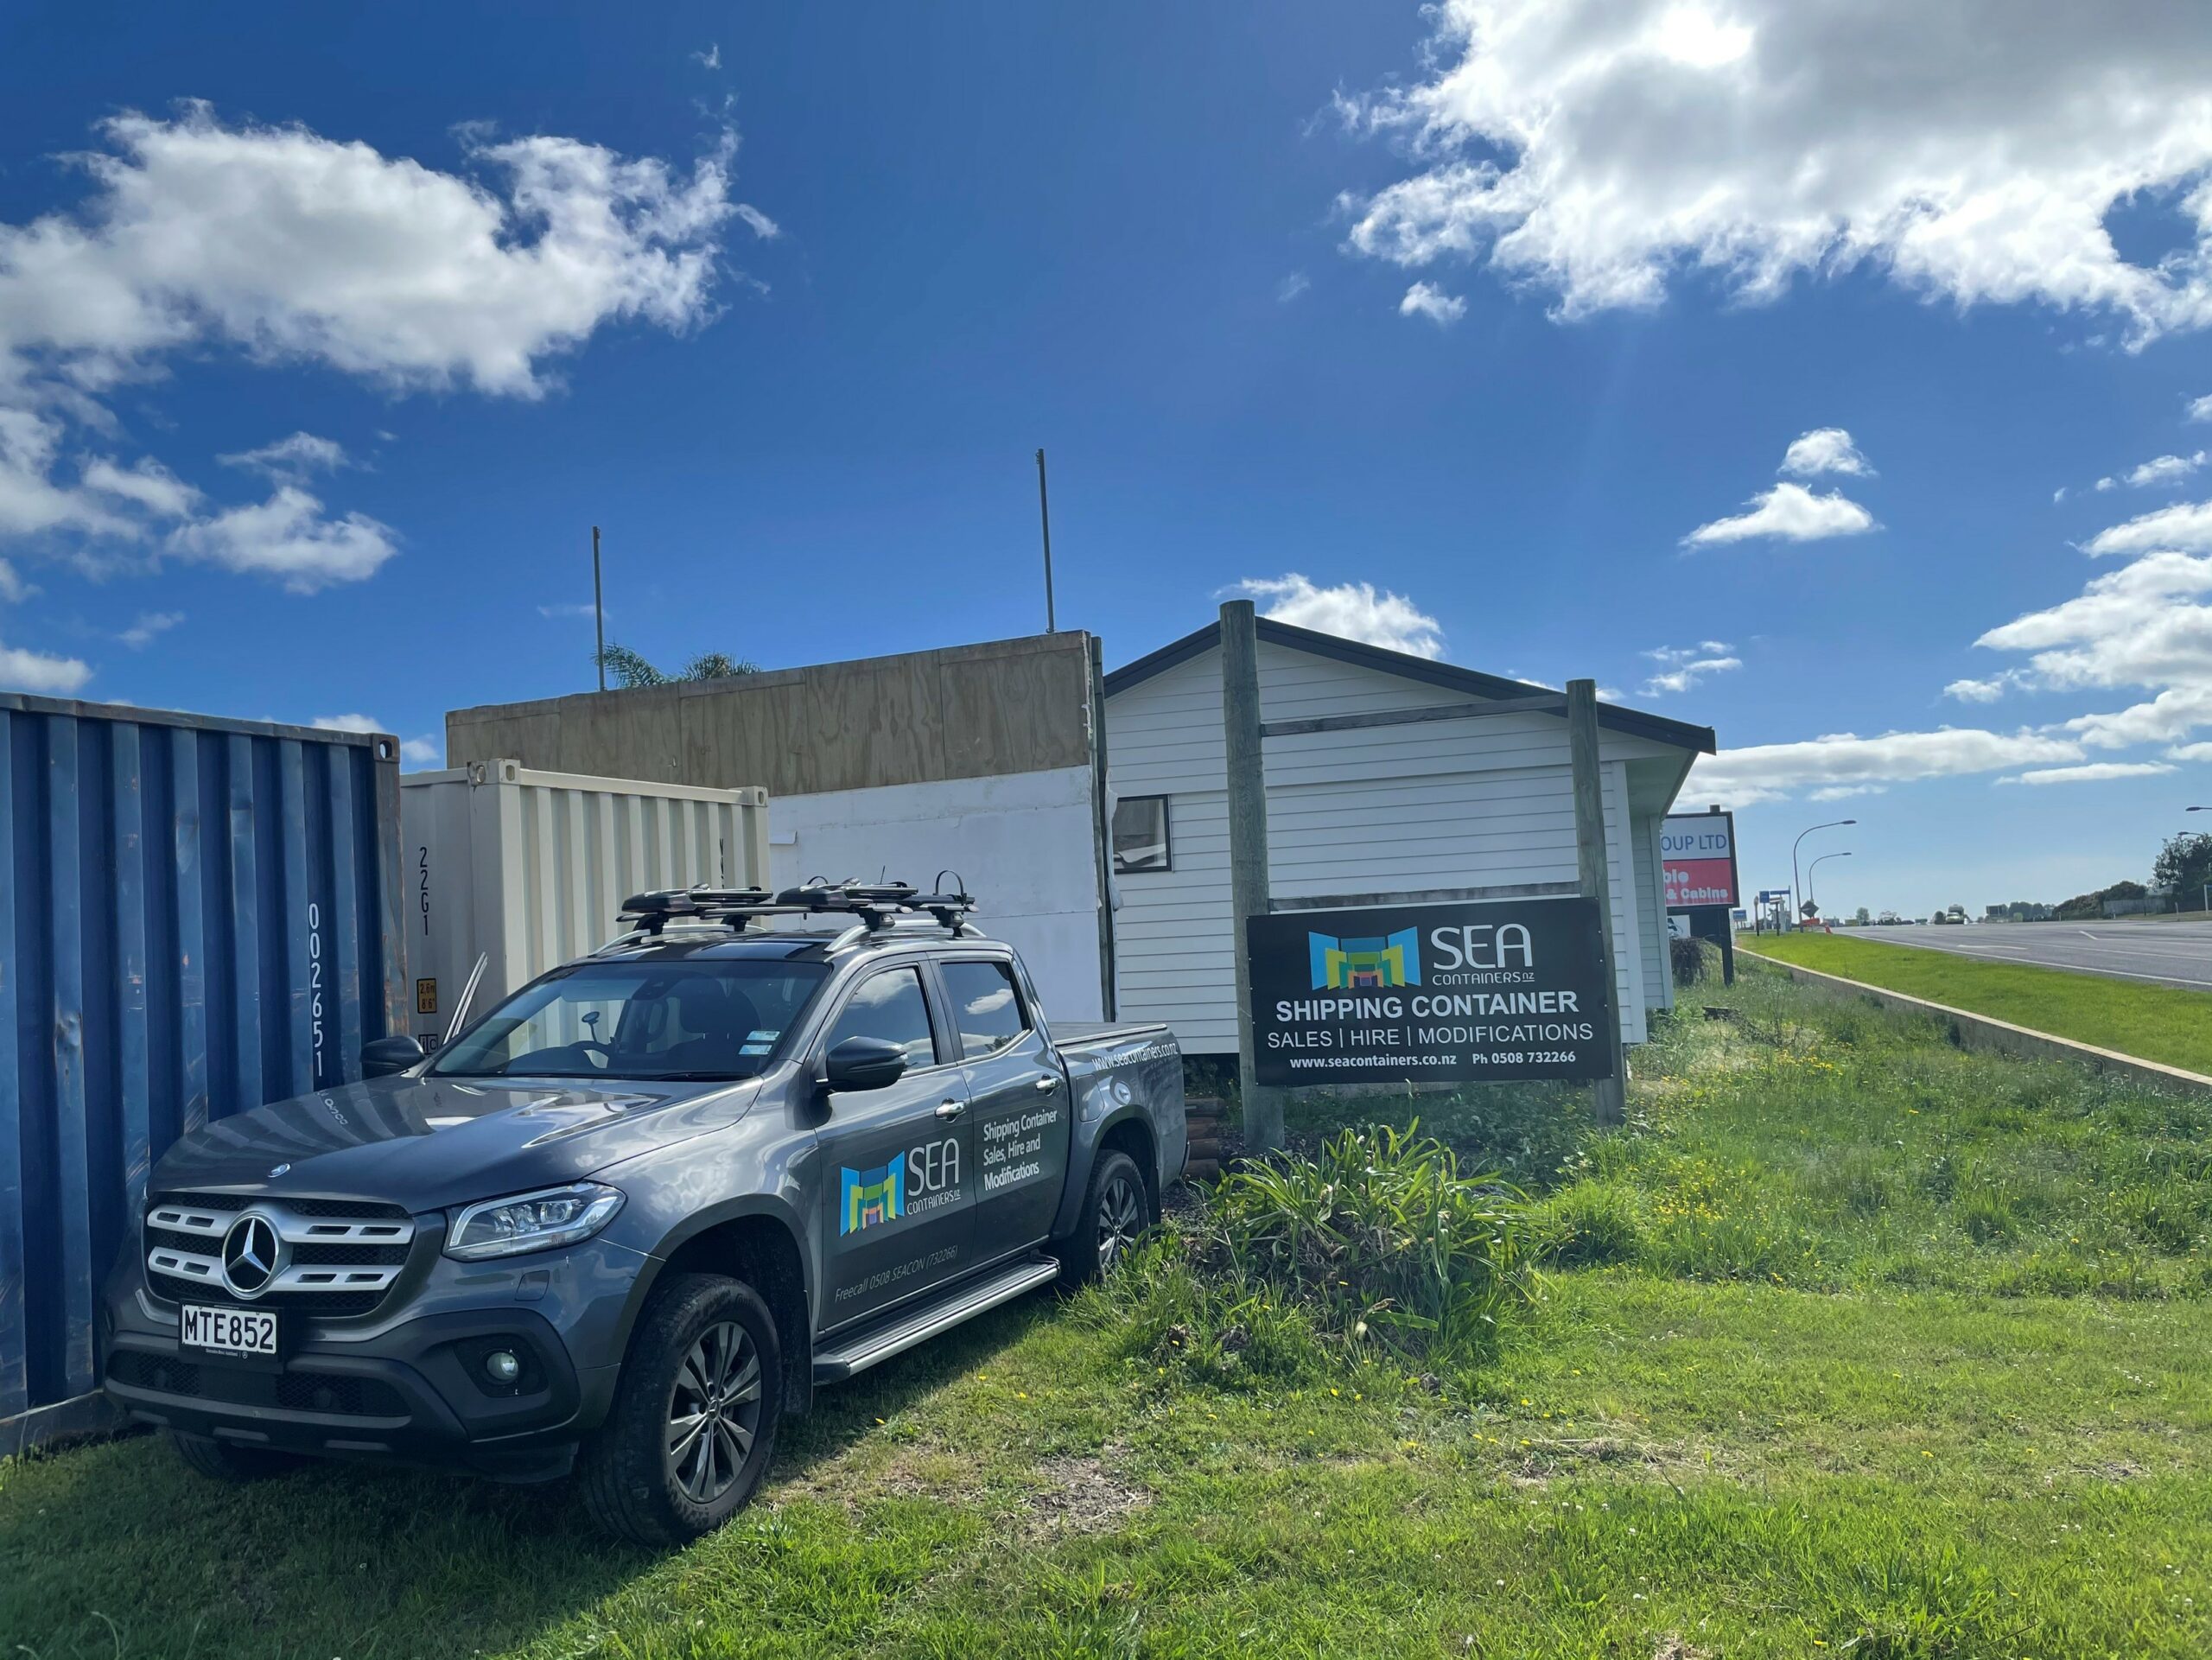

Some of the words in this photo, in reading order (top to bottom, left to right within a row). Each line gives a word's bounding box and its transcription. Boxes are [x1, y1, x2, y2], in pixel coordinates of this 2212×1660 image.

[1699, 834, 1727, 849] LTD
[419, 846, 429, 936] 22G1
[1666, 888, 1677, 900] &
[1680, 887, 1728, 900] Cabins
[1430, 923, 1533, 970] SEA
[308, 903, 323, 1078] 002651
[1275, 997, 1402, 1022] SHIPPING
[1411, 990, 1580, 1018] CONTAINER
[1268, 1030, 1333, 1048] SALES
[1351, 1028, 1401, 1046] HIRE
[1419, 1022, 1594, 1045] MODIFICATIONS
[1091, 1042, 1179, 1071] www.seacontainers.co.nz
[1289, 1053, 1458, 1069] www.seacontainers.co.nz
[1471, 1053, 1488, 1065] Ph
[1491, 1052, 1523, 1064] 0508
[1528, 1050, 1577, 1063] 732266
[983, 1117, 1020, 1143] Shipping
[1020, 1109, 1058, 1131] Container
[983, 1145, 1007, 1167] Sales,
[1007, 1140, 1025, 1159] Hire
[1026, 1132, 1041, 1153] and
[907, 1138, 960, 1197] SEA
[983, 1161, 1039, 1191] Modifications
[835, 1277, 869, 1303] Freecall
[869, 1269, 891, 1290] 0508
[891, 1257, 926, 1282] SEACON
[925, 1244, 958, 1270] (732266)
[185, 1310, 274, 1350] MTE852
